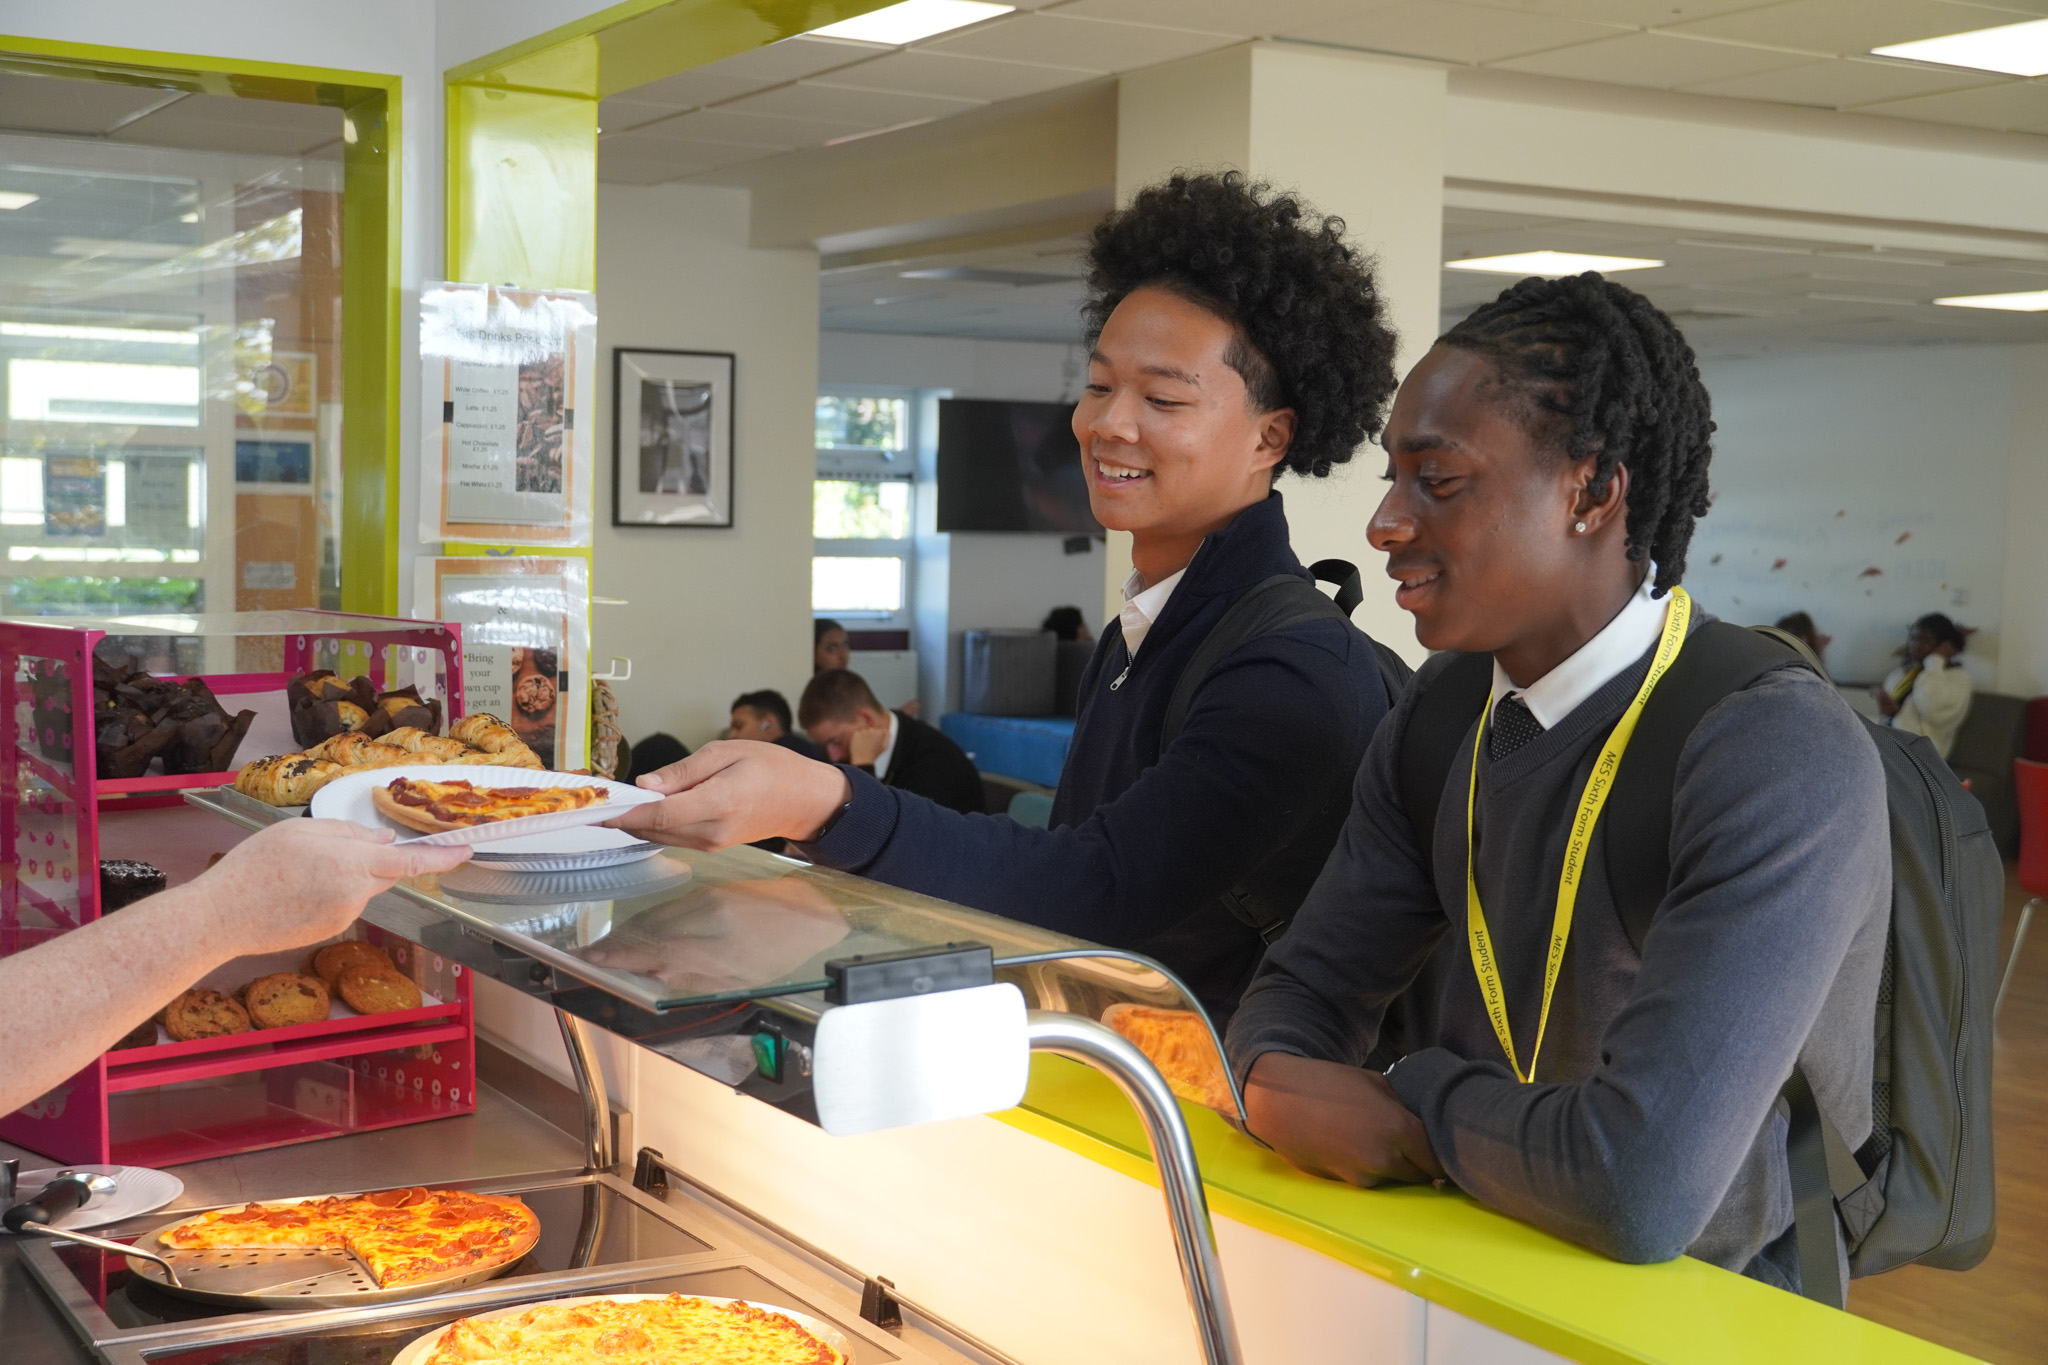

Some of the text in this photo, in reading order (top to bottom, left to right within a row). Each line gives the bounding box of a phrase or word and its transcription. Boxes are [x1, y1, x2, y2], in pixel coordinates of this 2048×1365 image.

[497, 606, 507, 615] &
[1671, 608, 1685, 633] Sixth
[468, 652, 494, 666] Bring
[1662, 632, 1679, 661] Form
[470, 669, 491, 681] your
[1638, 662, 1665, 706] Student
[483, 684, 500, 695] cup
[472, 699, 486, 710] get
[489, 699, 501, 707] an
[1564, 750, 1617, 885] MES Sixth Form Student
[1475, 930, 1492, 973] Student
[1551, 934, 1563, 960] MES
[1485, 975, 1499, 1005] Form
[1492, 1006, 1506, 1036] Sixth
